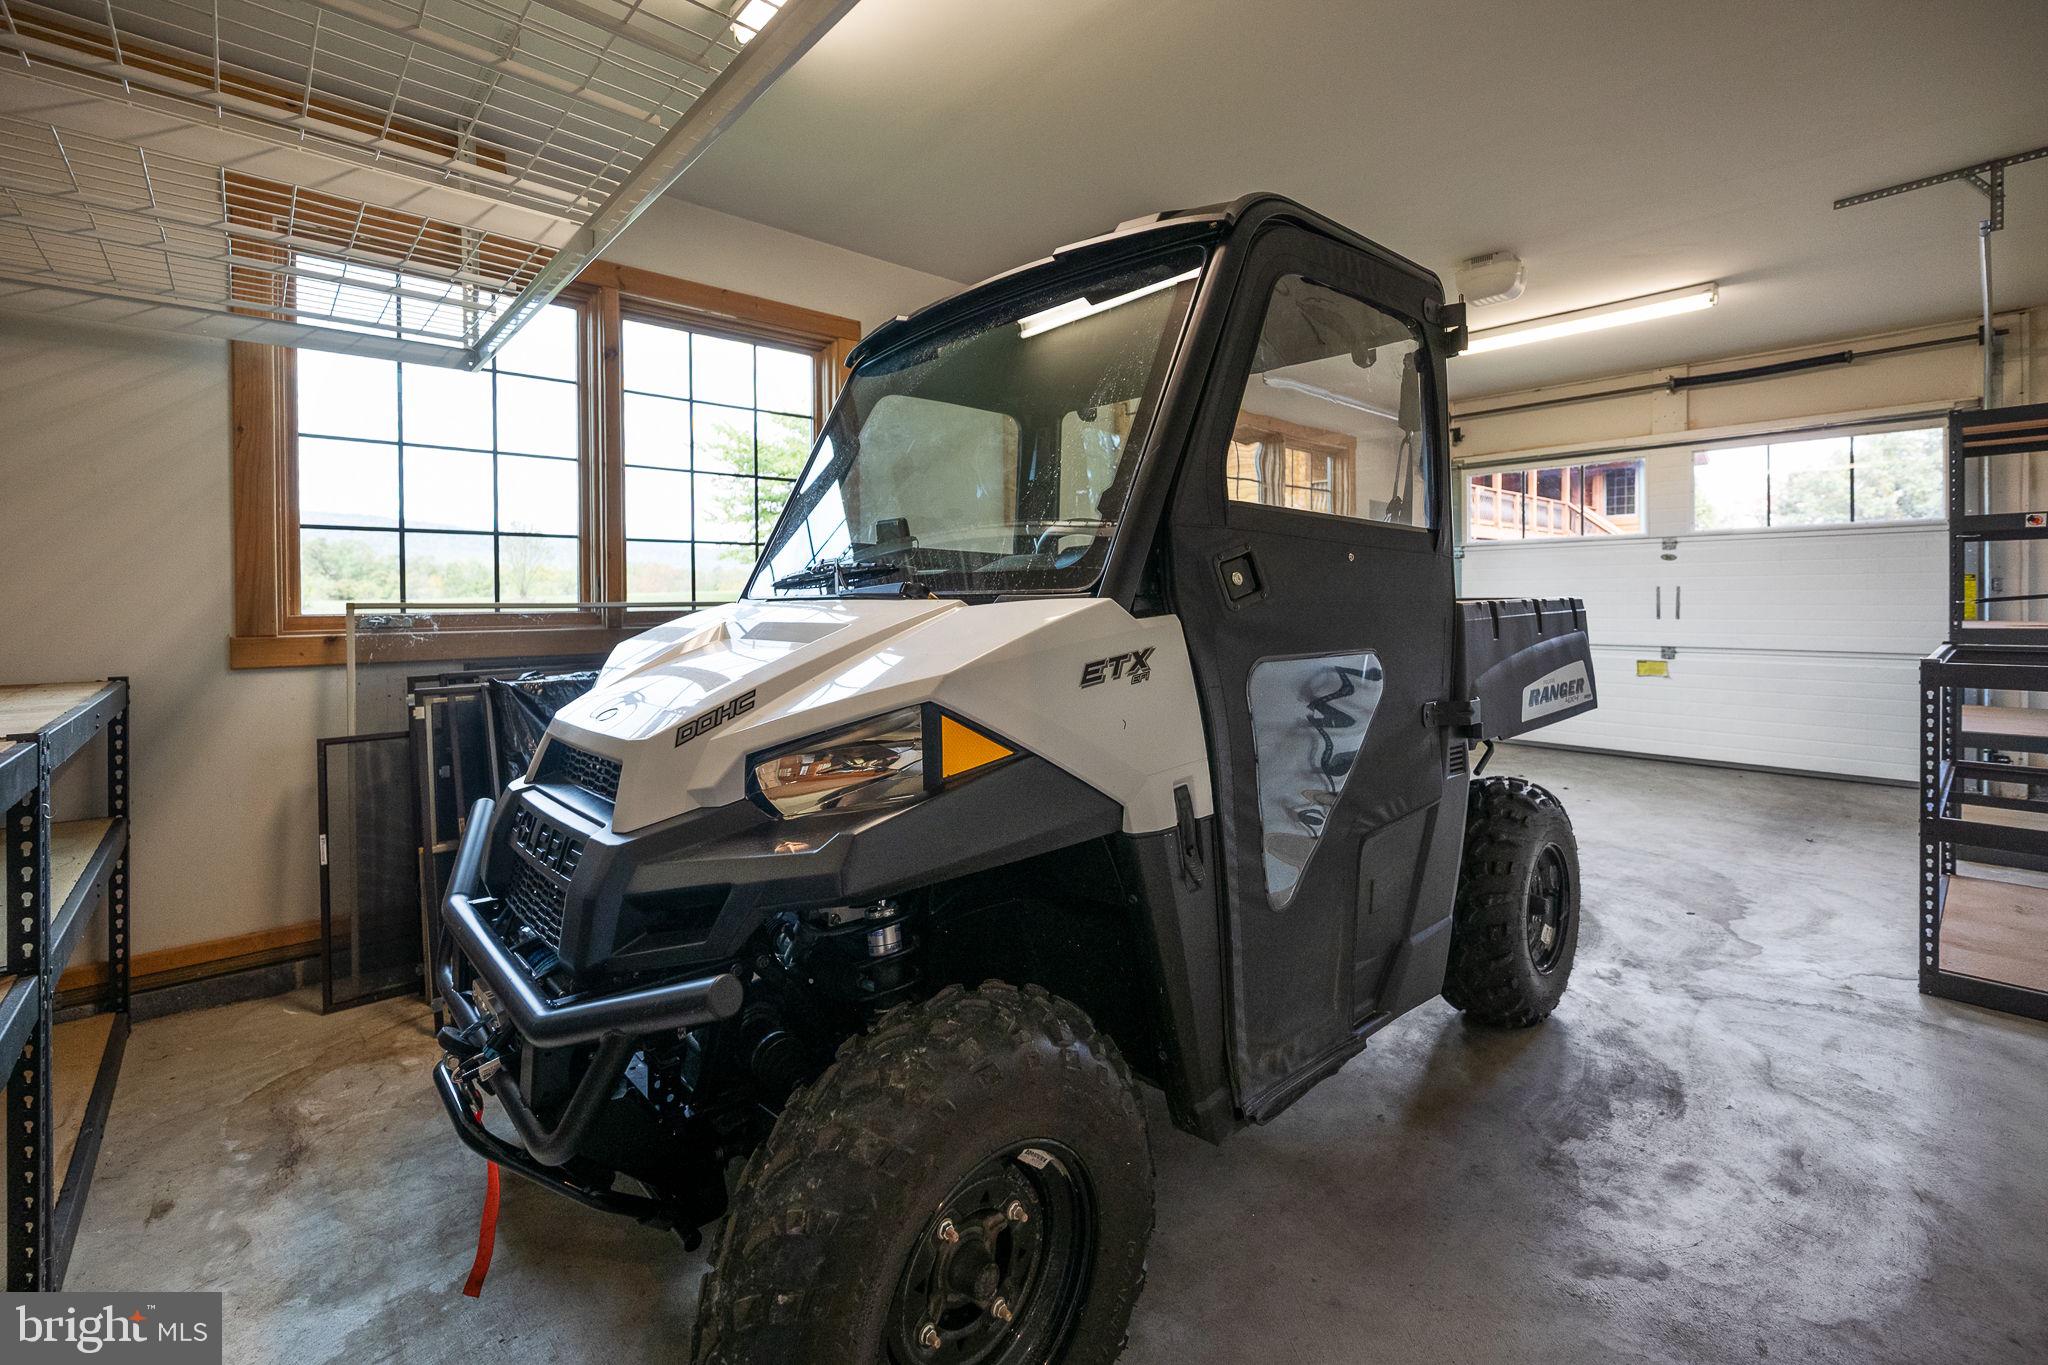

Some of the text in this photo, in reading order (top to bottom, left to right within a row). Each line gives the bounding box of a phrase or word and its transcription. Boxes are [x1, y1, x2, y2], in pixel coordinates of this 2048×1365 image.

[1079, 646, 1156, 689] ETX
[1528, 677, 1585, 708] RANGER
[674, 688, 757, 749] DOHC
